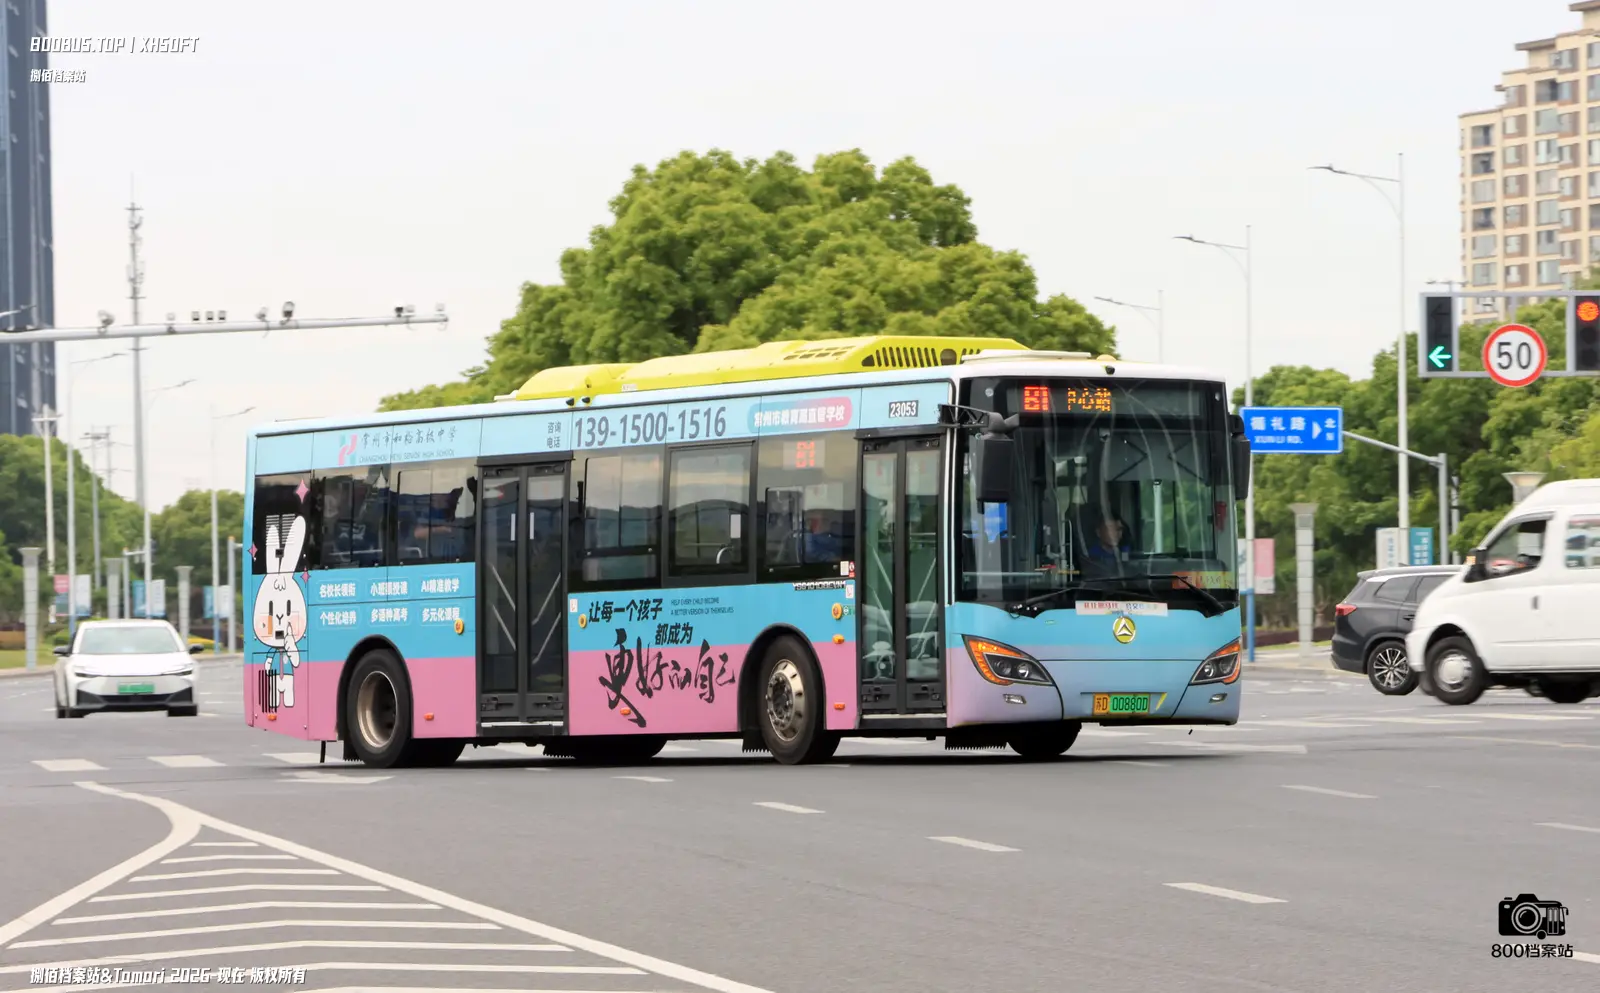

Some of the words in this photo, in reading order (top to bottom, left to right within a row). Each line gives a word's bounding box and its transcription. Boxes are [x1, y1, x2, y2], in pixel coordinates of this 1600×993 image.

[1497, 342, 1531, 370] 50
[890, 402, 916, 417] 23053
[575, 406, 726, 447] 139-1500-1516
[546, 437, 561, 449] 电话
[421, 578, 460, 593] AI精准教学
[320, 610, 357, 625] 个性化培养
[422, 607, 460, 622] 多元化课程
[589, 598, 663, 623] 让每一个孩子
[655, 622, 693, 645] 都成为
[599, 628, 735, 727] 更好的自己
